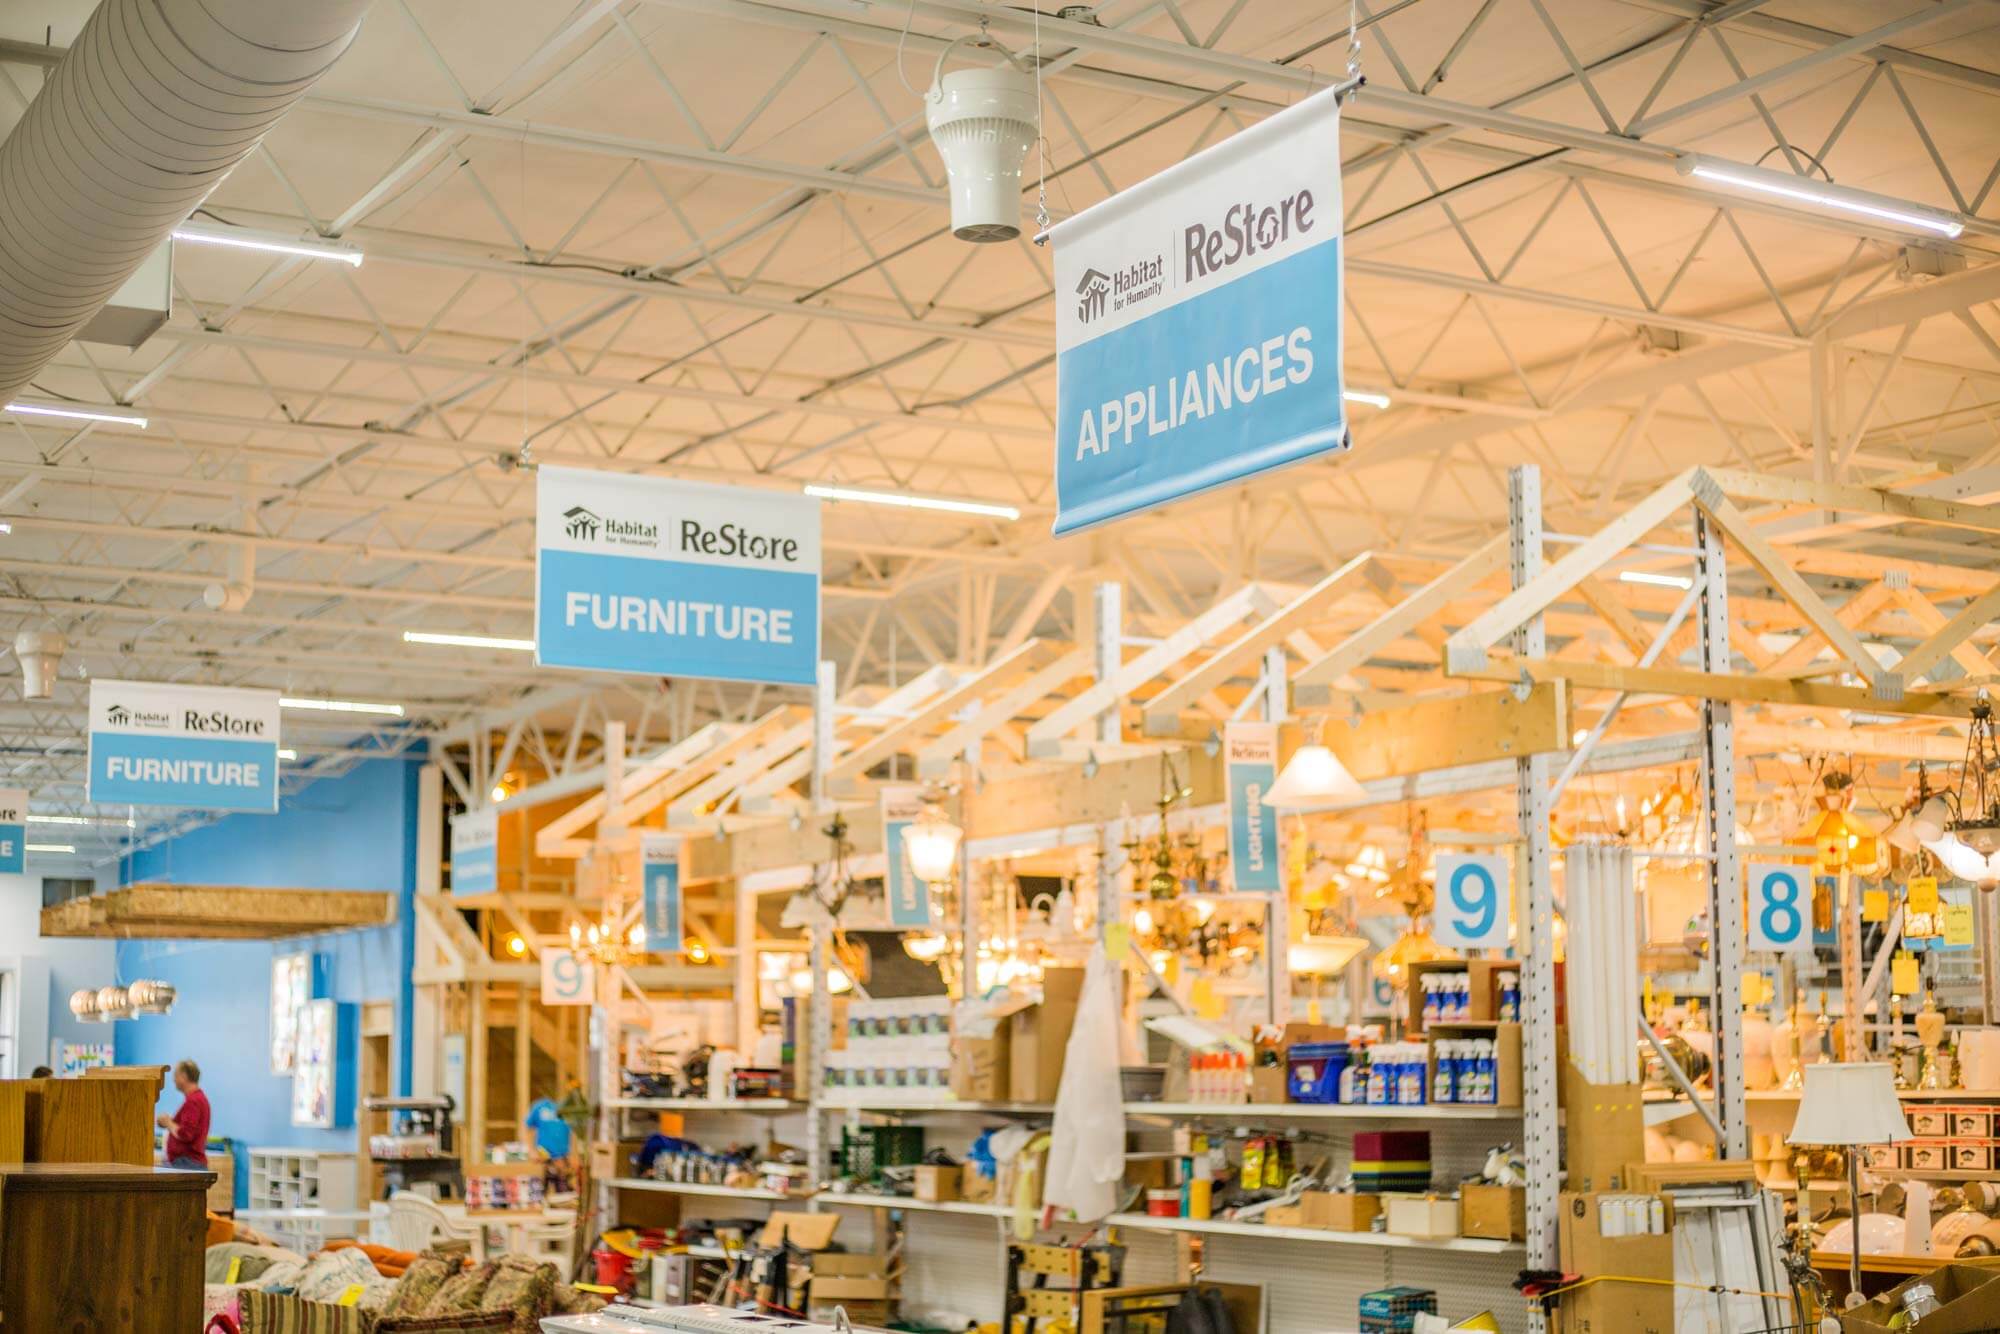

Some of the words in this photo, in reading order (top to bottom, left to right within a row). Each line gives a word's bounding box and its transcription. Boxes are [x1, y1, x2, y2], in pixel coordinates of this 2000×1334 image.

[1114, 254, 1163, 296] Habitat
[1185, 188, 1314, 282] ReStore
[1114, 298, 1124, 312] for
[1126, 281, 1163, 306] Humanity
[1076, 326, 1313, 461] APPLIANCES
[606, 519, 657, 537] Habitat
[681, 519, 798, 561] ReStore
[566, 592, 793, 644] FURNITURE
[185, 709, 264, 735] ReStore
[107, 757, 260, 787] FURNITURE
[1246, 783, 1264, 871] LIGHTING
[1450, 863, 1496, 939] 9
[1760, 872, 1802, 944] 8
[553, 955, 584, 997] 9
